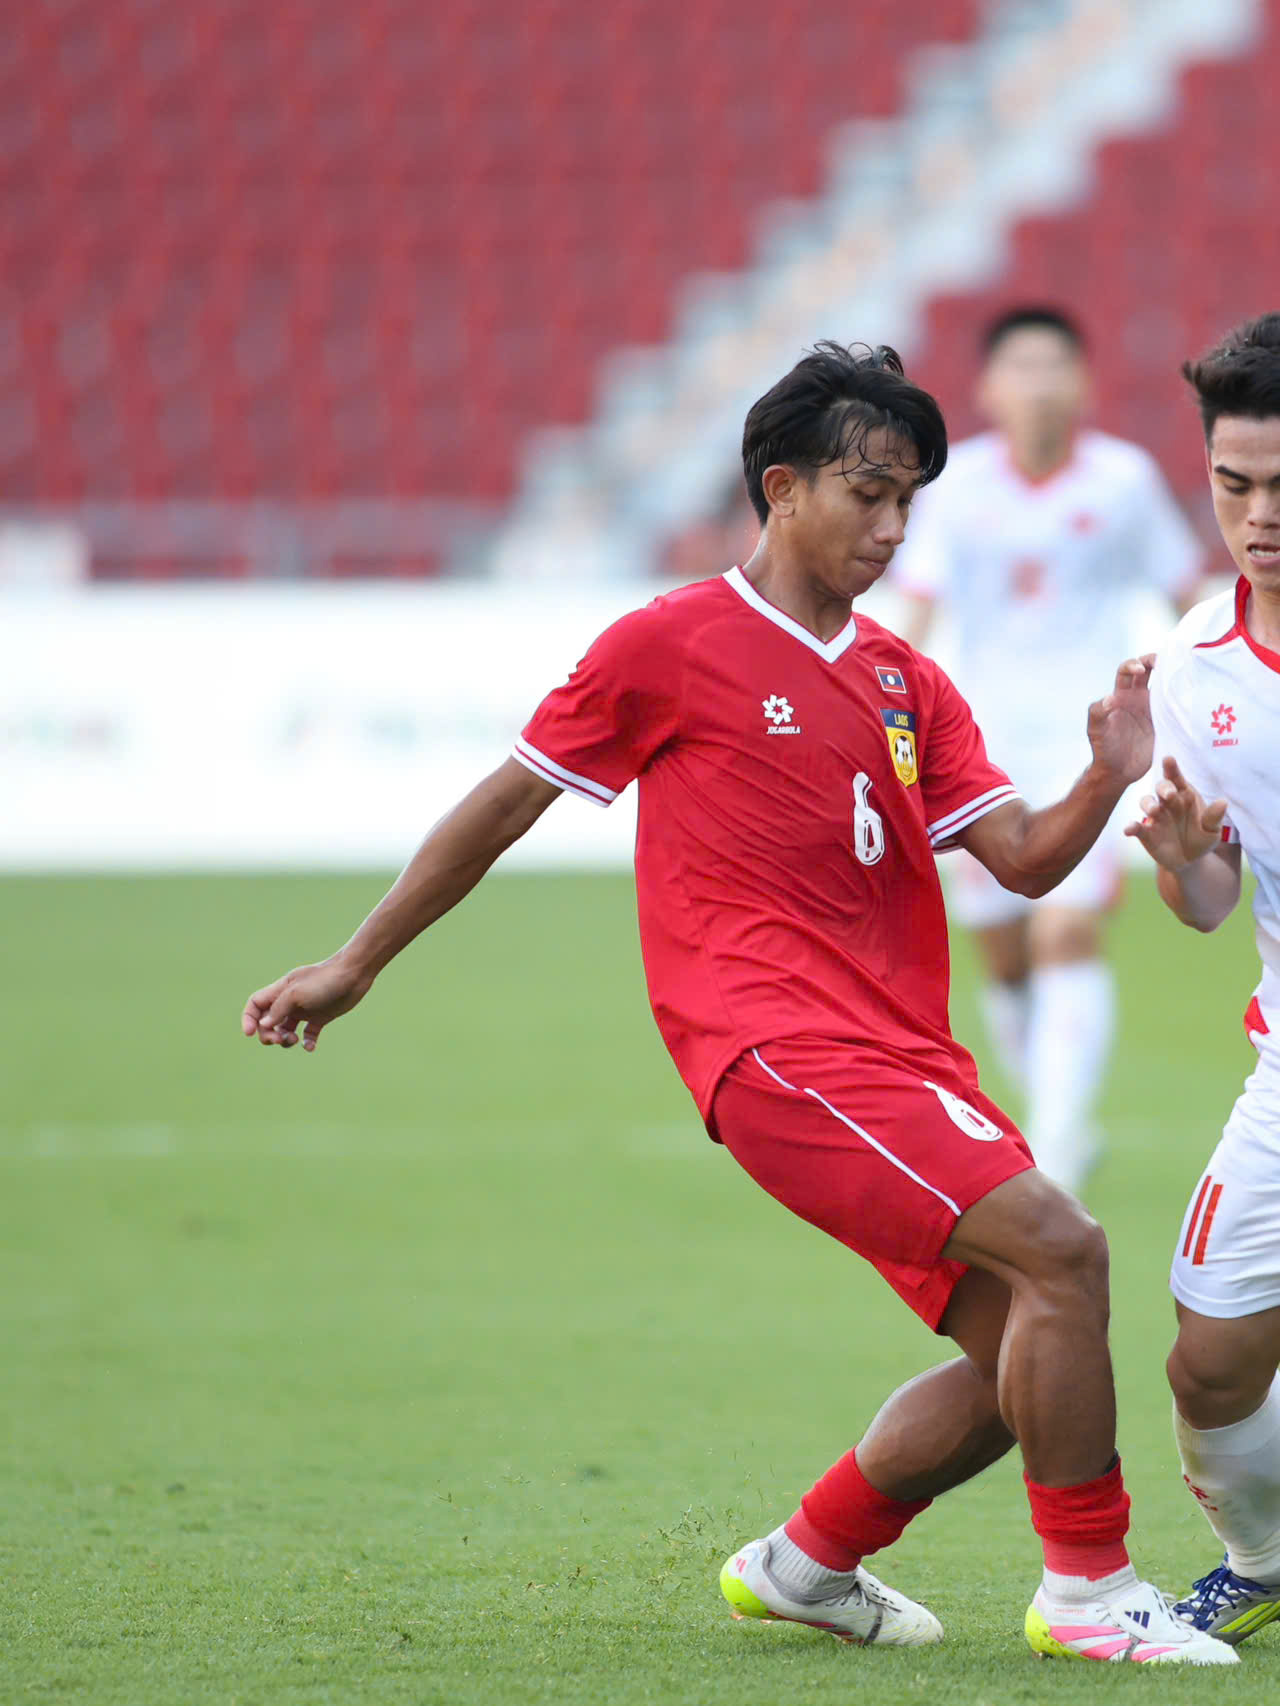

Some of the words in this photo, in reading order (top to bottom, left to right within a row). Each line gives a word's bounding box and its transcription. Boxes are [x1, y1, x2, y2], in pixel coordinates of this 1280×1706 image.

[853, 772, 885, 866] 6
[923, 1080, 1004, 1142] 6
[1183, 1175, 1223, 1265] 11
